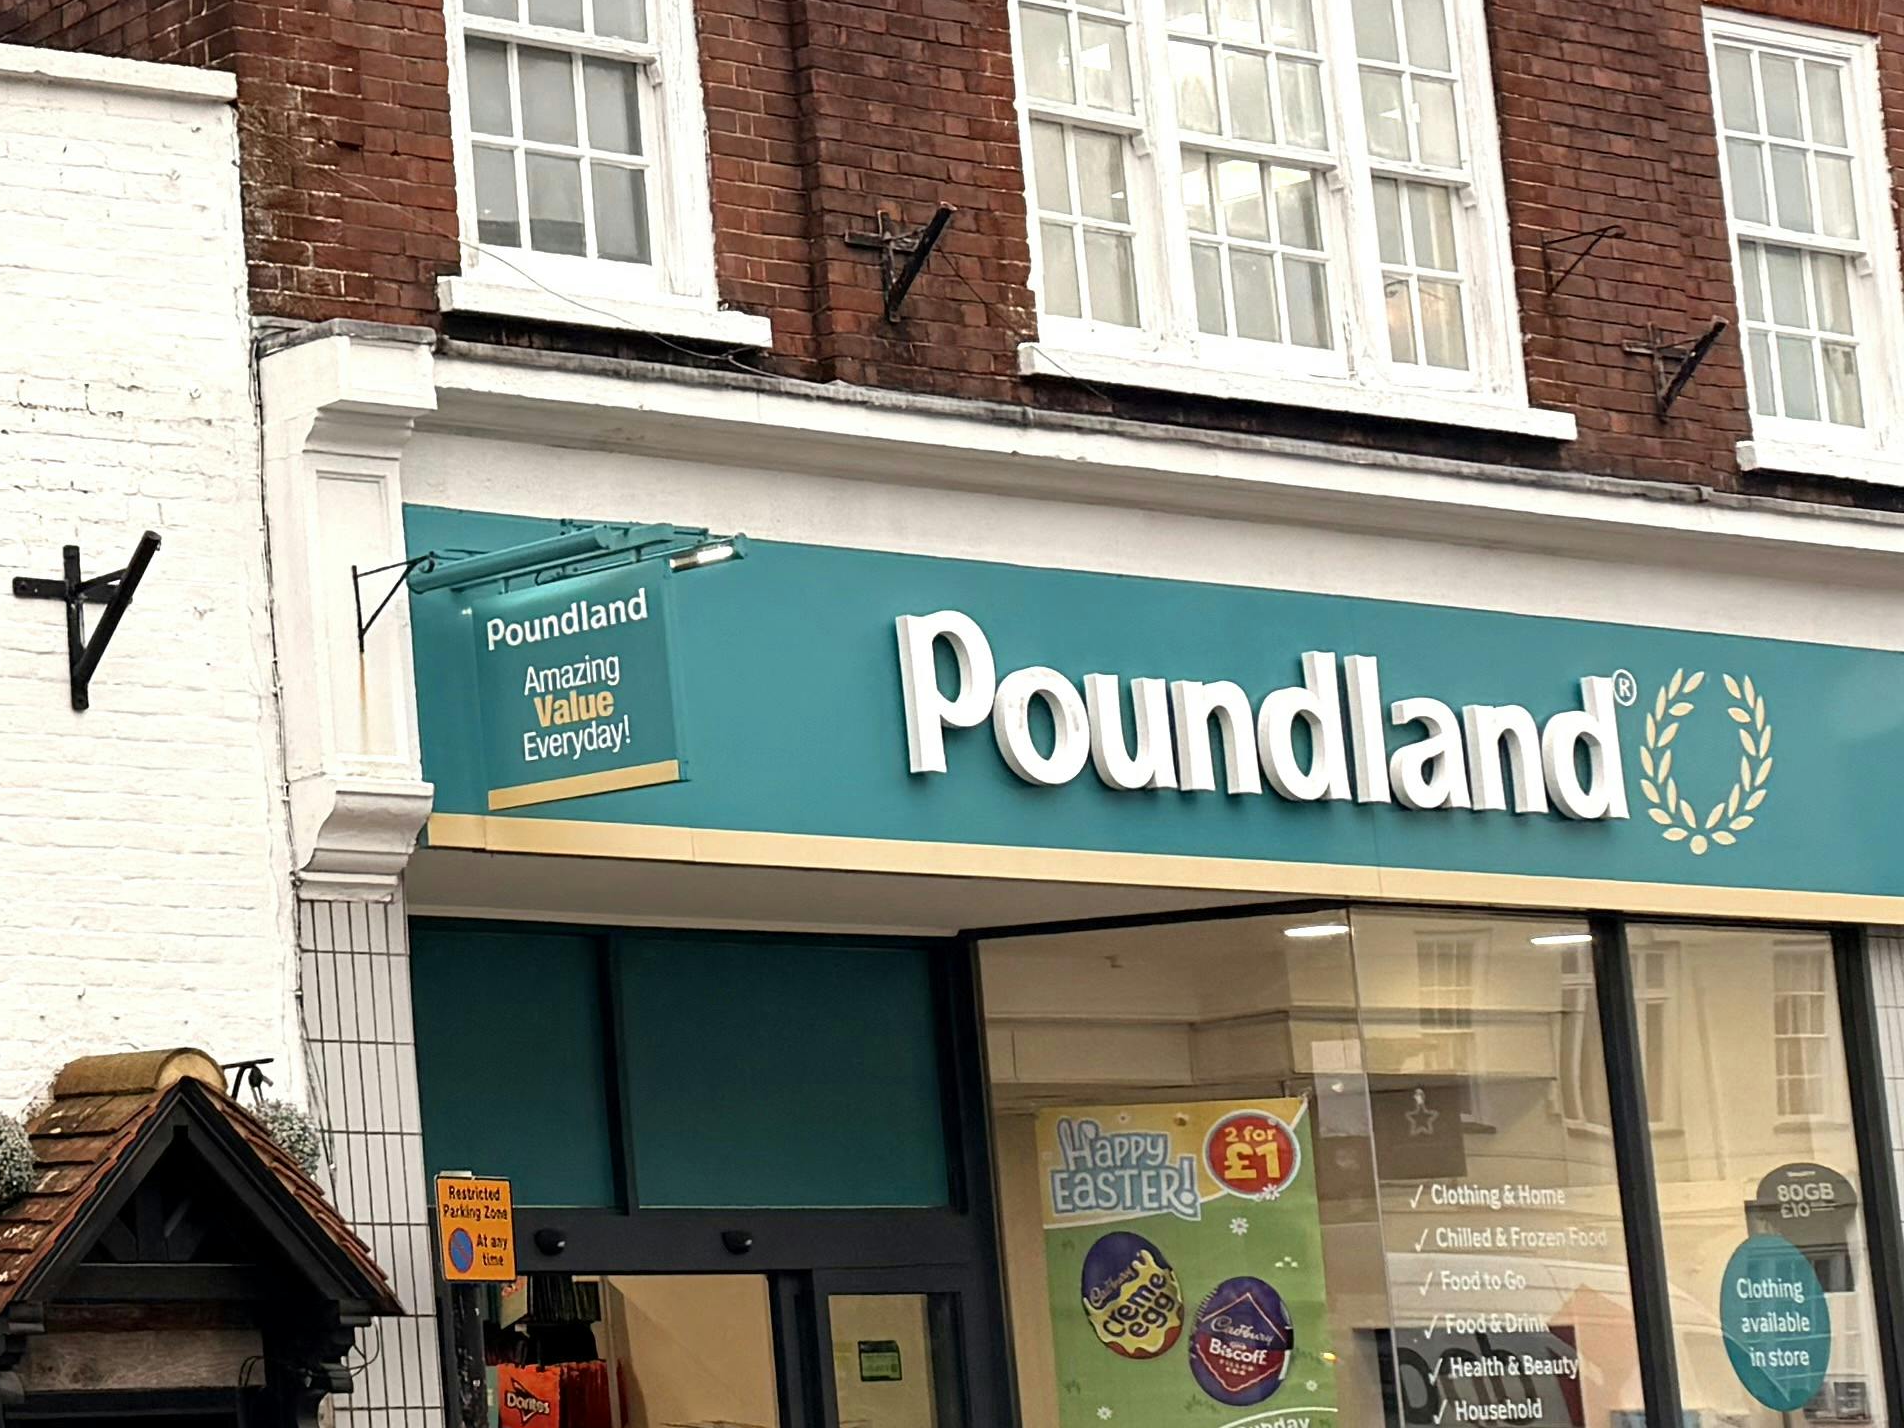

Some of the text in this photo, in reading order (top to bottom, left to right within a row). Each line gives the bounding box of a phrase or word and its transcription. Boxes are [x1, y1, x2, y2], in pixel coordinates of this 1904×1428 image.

[486, 587, 649, 651] Poundland
[524, 654, 620, 696] Amazing
[533, 689, 615, 728] Value
[895, 609, 1631, 820] Poundland
[523, 714, 632, 762] Everyday!
[1225, 1126, 1277, 1142] 2 for
[1224, 1142, 1281, 1180] £1
[448, 1185, 501, 1201] Restricted
[1431, 1184, 1566, 1210] Clothing & Home
[1777, 1182, 1834, 1202] 80GB
[443, 1204, 508, 1221] Parking Zone
[476, 1234, 508, 1251] At any
[1435, 1227, 1608, 1248] Chilled & Frozen Food
[483, 1253, 504, 1266] time
[1441, 1271, 1527, 1291] Food to Go
[1736, 1278, 1806, 1304] Clothing
[1128, 1291, 1176, 1339] egg
[1445, 1313, 1550, 1335] Food & Drink
[1742, 1312, 1811, 1333] available
[1210, 1315, 1275, 1345] Cadbury
[1209, 1337, 1268, 1365] Biscoff
[1750, 1347, 1811, 1367] in store
[1449, 1355, 1580, 1380] Health & Beauty
[506, 1392, 550, 1414] Doritos
[1455, 1398, 1543, 1422] Household
